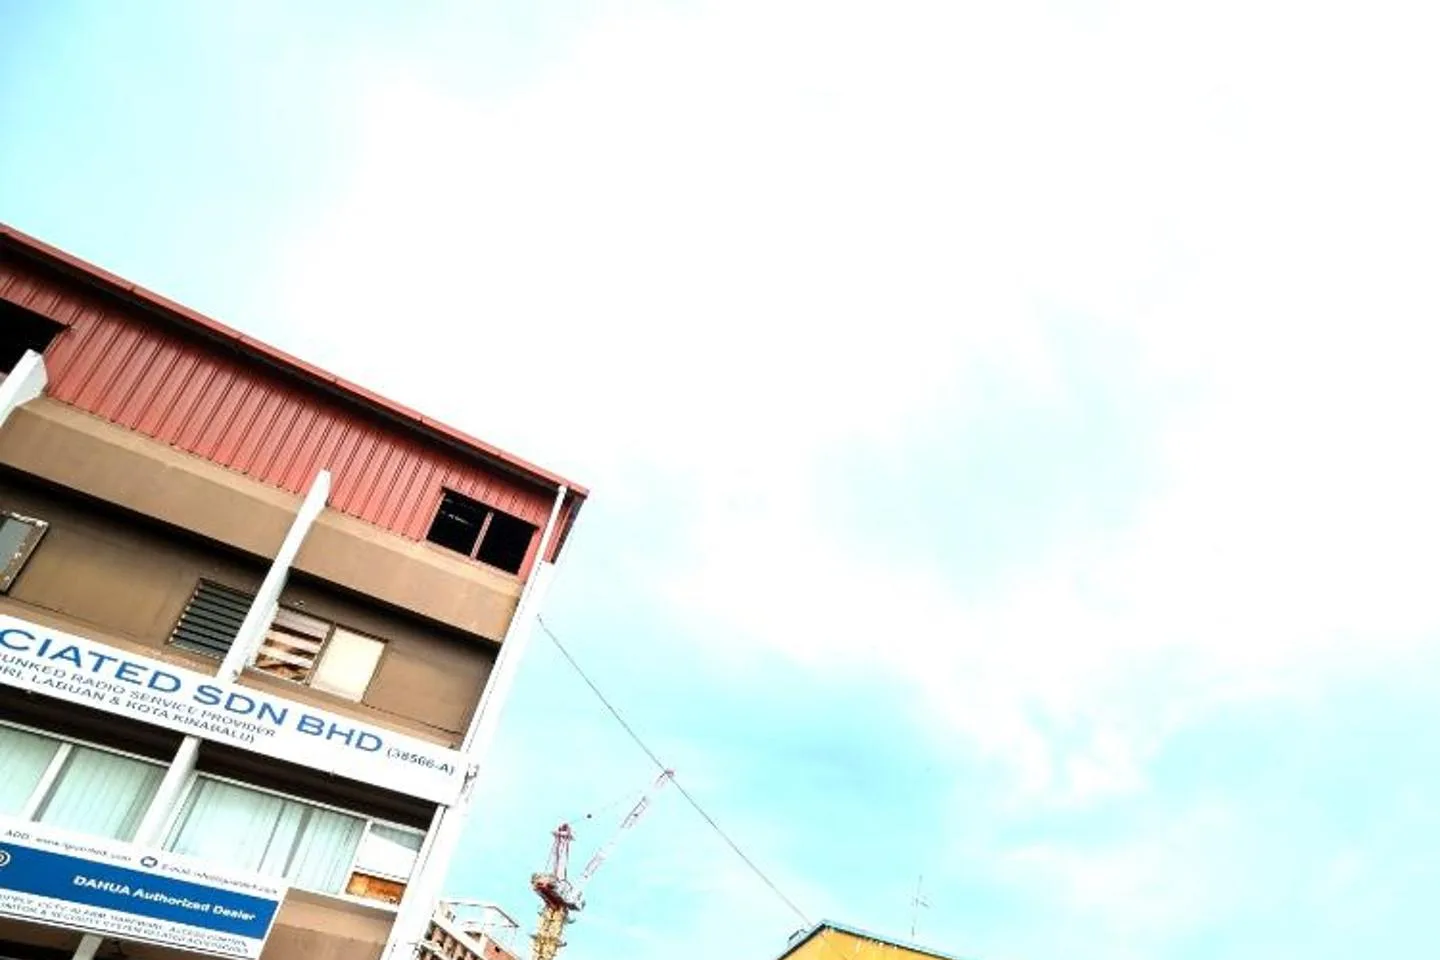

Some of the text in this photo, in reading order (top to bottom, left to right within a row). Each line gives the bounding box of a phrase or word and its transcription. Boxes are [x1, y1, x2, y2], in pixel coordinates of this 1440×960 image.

[0, 628, 182, 694] CIATED
[193, 684, 289, 726] SDN
[296, 714, 383, 752] BHD
[0, 652, 276, 737] UNKED RADIO SERVICE PROVIDER
[31, 674, 106, 701] LABUAN
[109, 696, 120, 706] &
[125, 700, 169, 719] KOTA
[172, 712, 255, 744] KINABALU)
[73, 875, 257, 921] DAHUA Authorized Dealer
